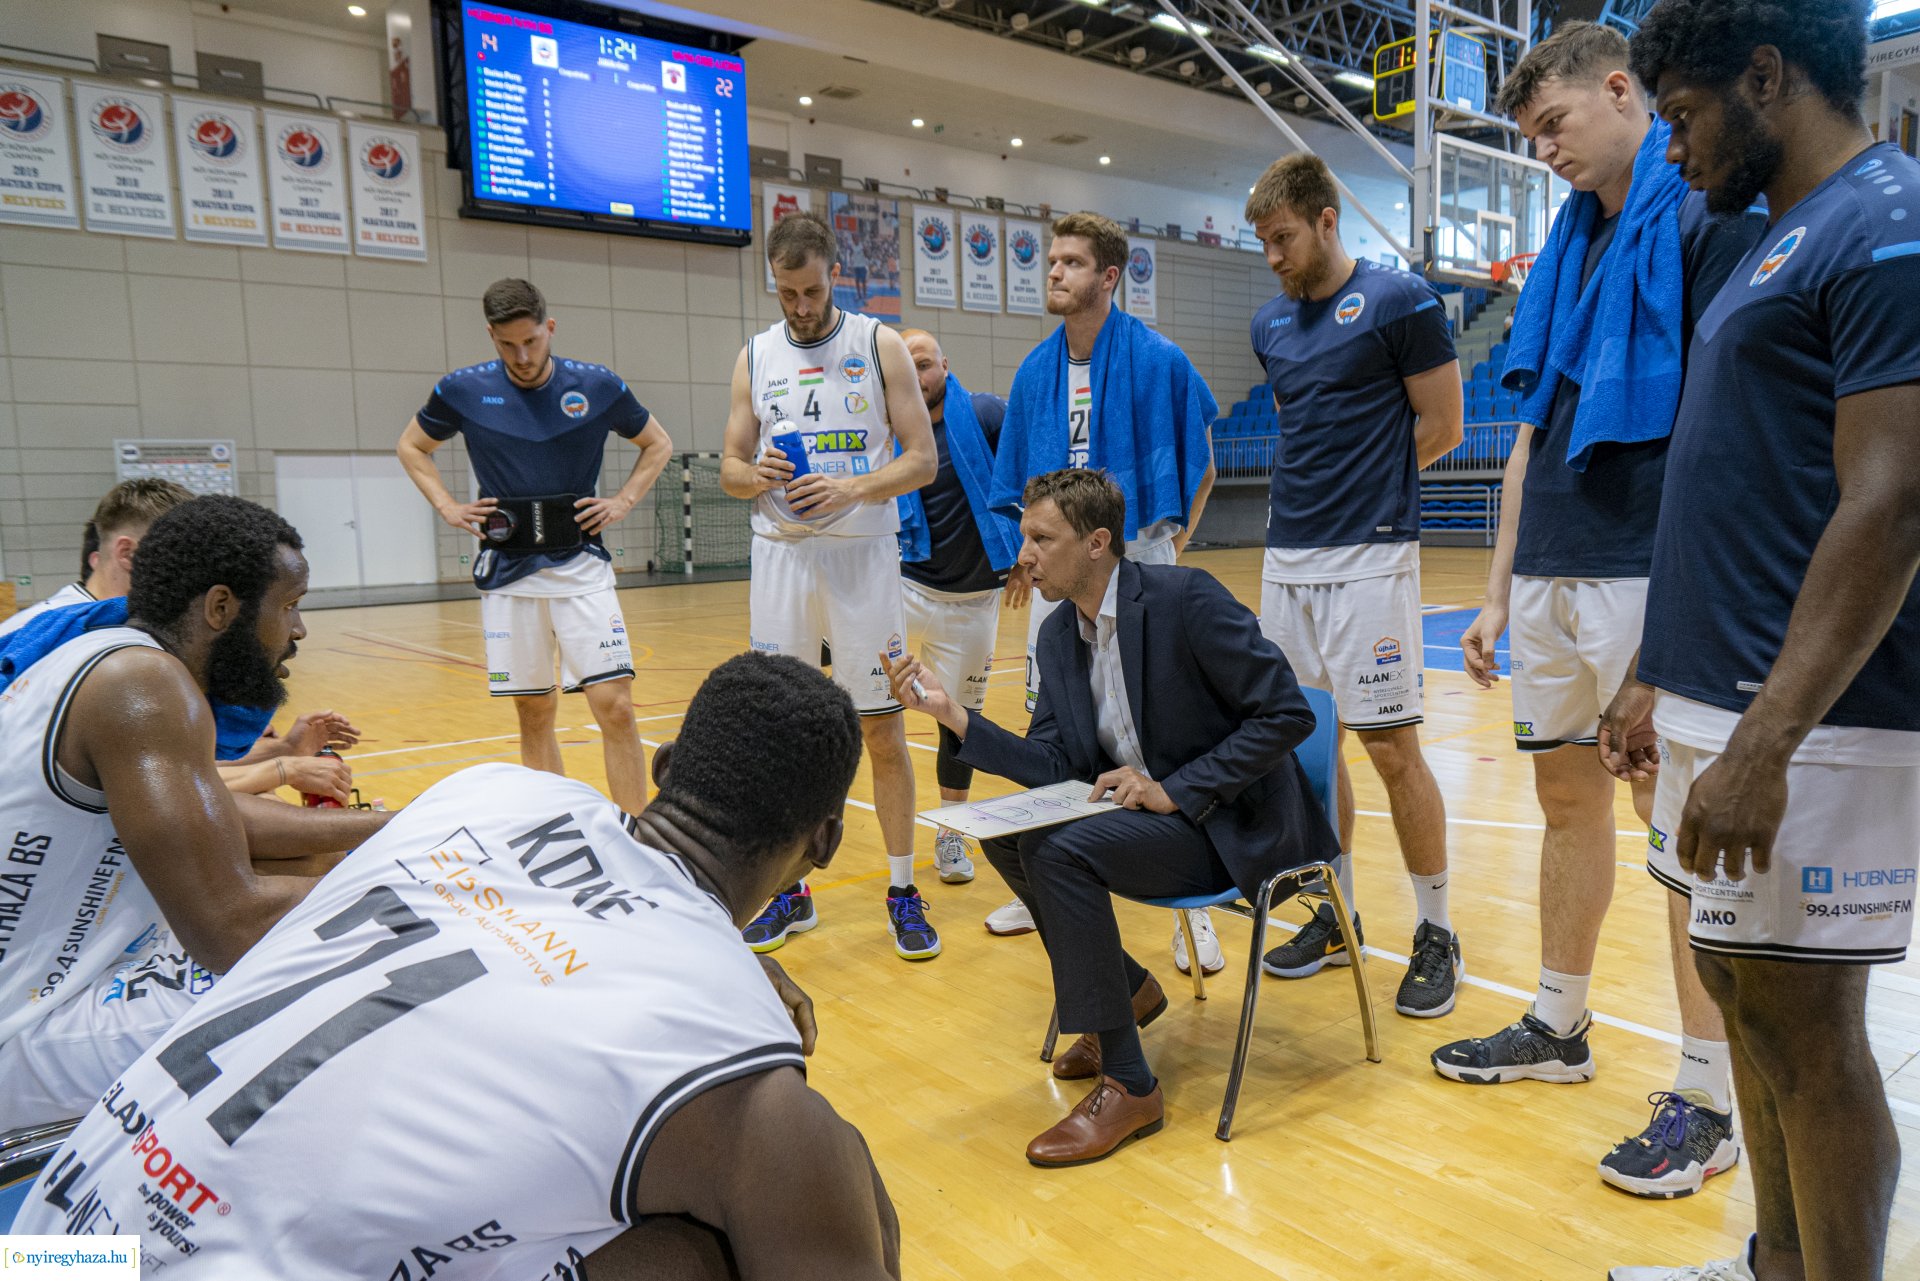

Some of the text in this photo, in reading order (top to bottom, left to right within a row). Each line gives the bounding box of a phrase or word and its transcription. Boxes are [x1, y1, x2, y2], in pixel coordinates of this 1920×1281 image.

[481, 33, 498, 52] 14
[599, 36, 637, 60] 1:24
[1869, 45, 1919, 64] YÍREGYH
[715, 77, 733, 97] 22
[1269, 316, 1292, 329] JAKO
[768, 378, 788, 388] JAKO
[481, 395, 504, 405] JAKO
[803, 389, 822, 422] 4
[1070, 409, 1091, 445] 2
[801, 432, 867, 454] PMIX
[809, 460, 846, 474] BNER
[1378, 703, 1404, 715] JAKO
[7, 831, 53, 866] BS
[1843, 868, 1916, 888] HÜBNER
[1695, 909, 1736, 926] JAKO
[1806, 899, 1912, 917] 99.4 SUNSHINE FM
[1538, 981, 1562, 994] AKO
[1682, 1051, 1709, 1065] AKO
[148, 1189, 196, 1231] power
[147, 1211, 200, 1257] is yours!
